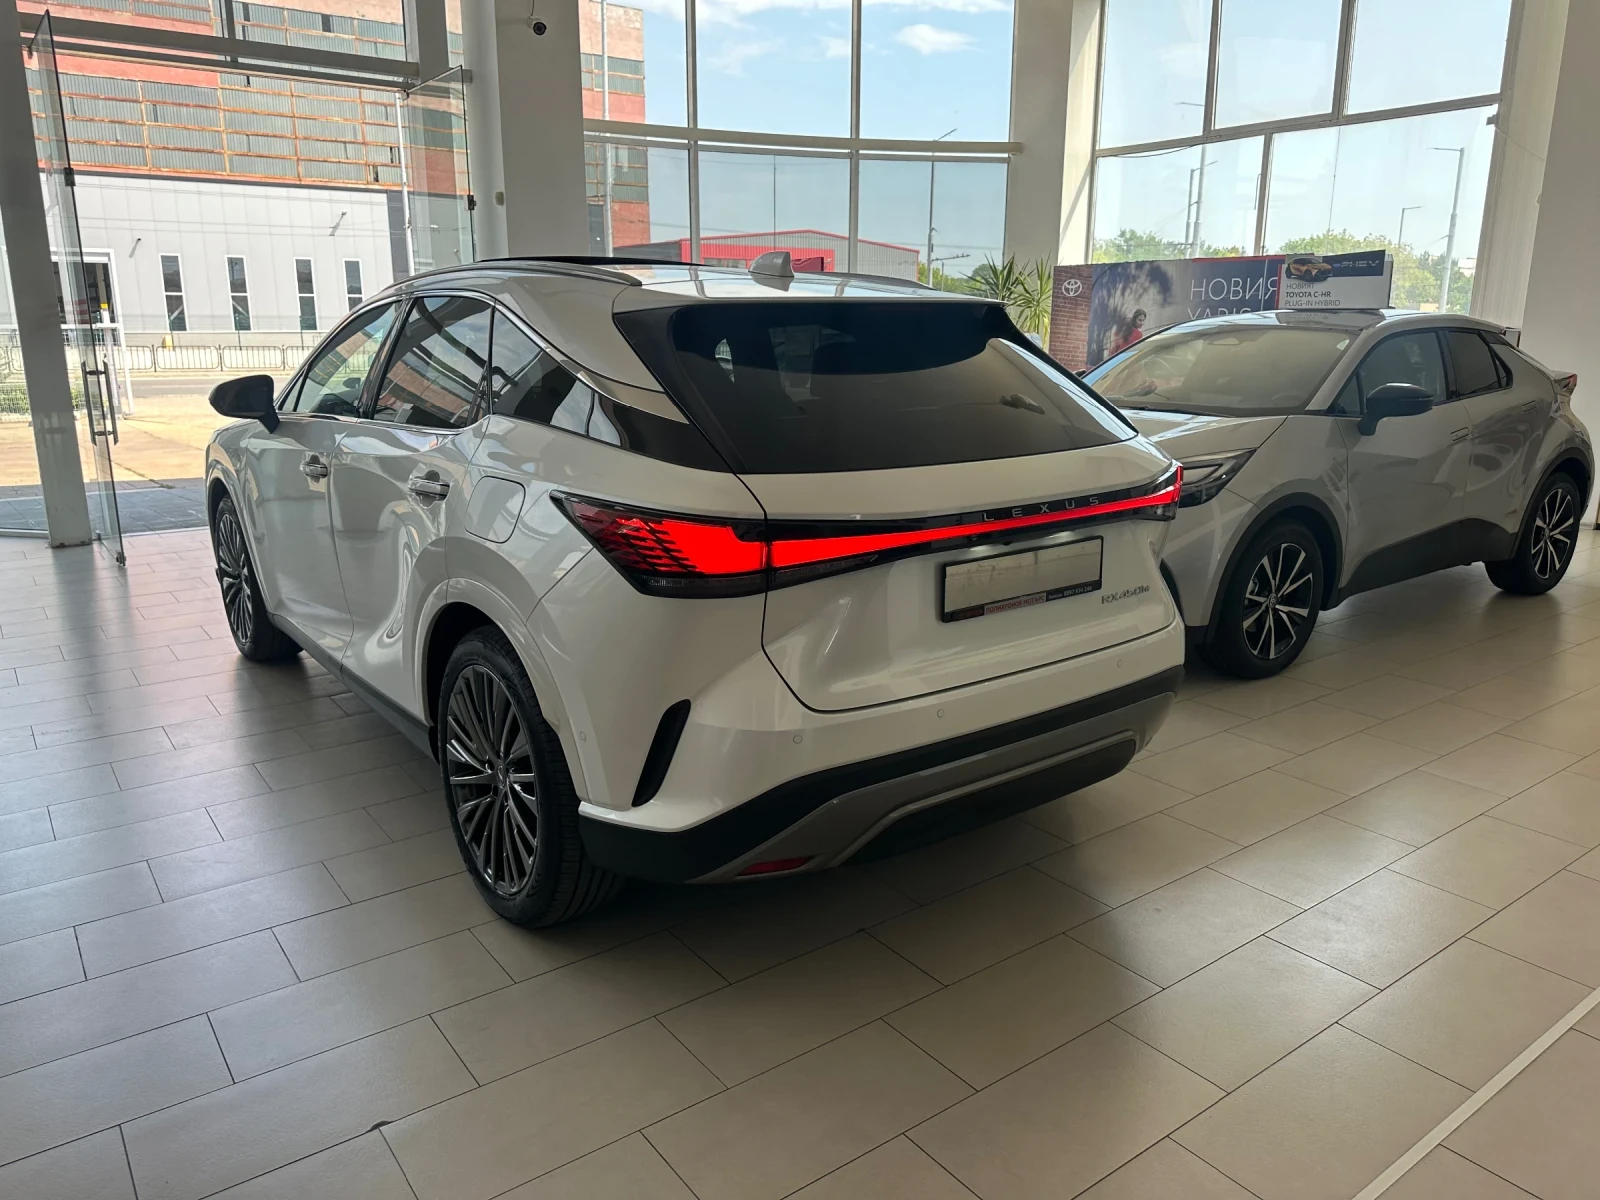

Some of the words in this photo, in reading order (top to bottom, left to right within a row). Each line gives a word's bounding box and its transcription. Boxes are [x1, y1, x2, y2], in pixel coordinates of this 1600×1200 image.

[1286, 282, 1315, 290] НОВИЯТ
[1314, 299, 1341, 307] HYBRID
[982, 496, 1099, 521] LEXUS
[985, 600, 1022, 613] ПОЛИХРОНОВ
